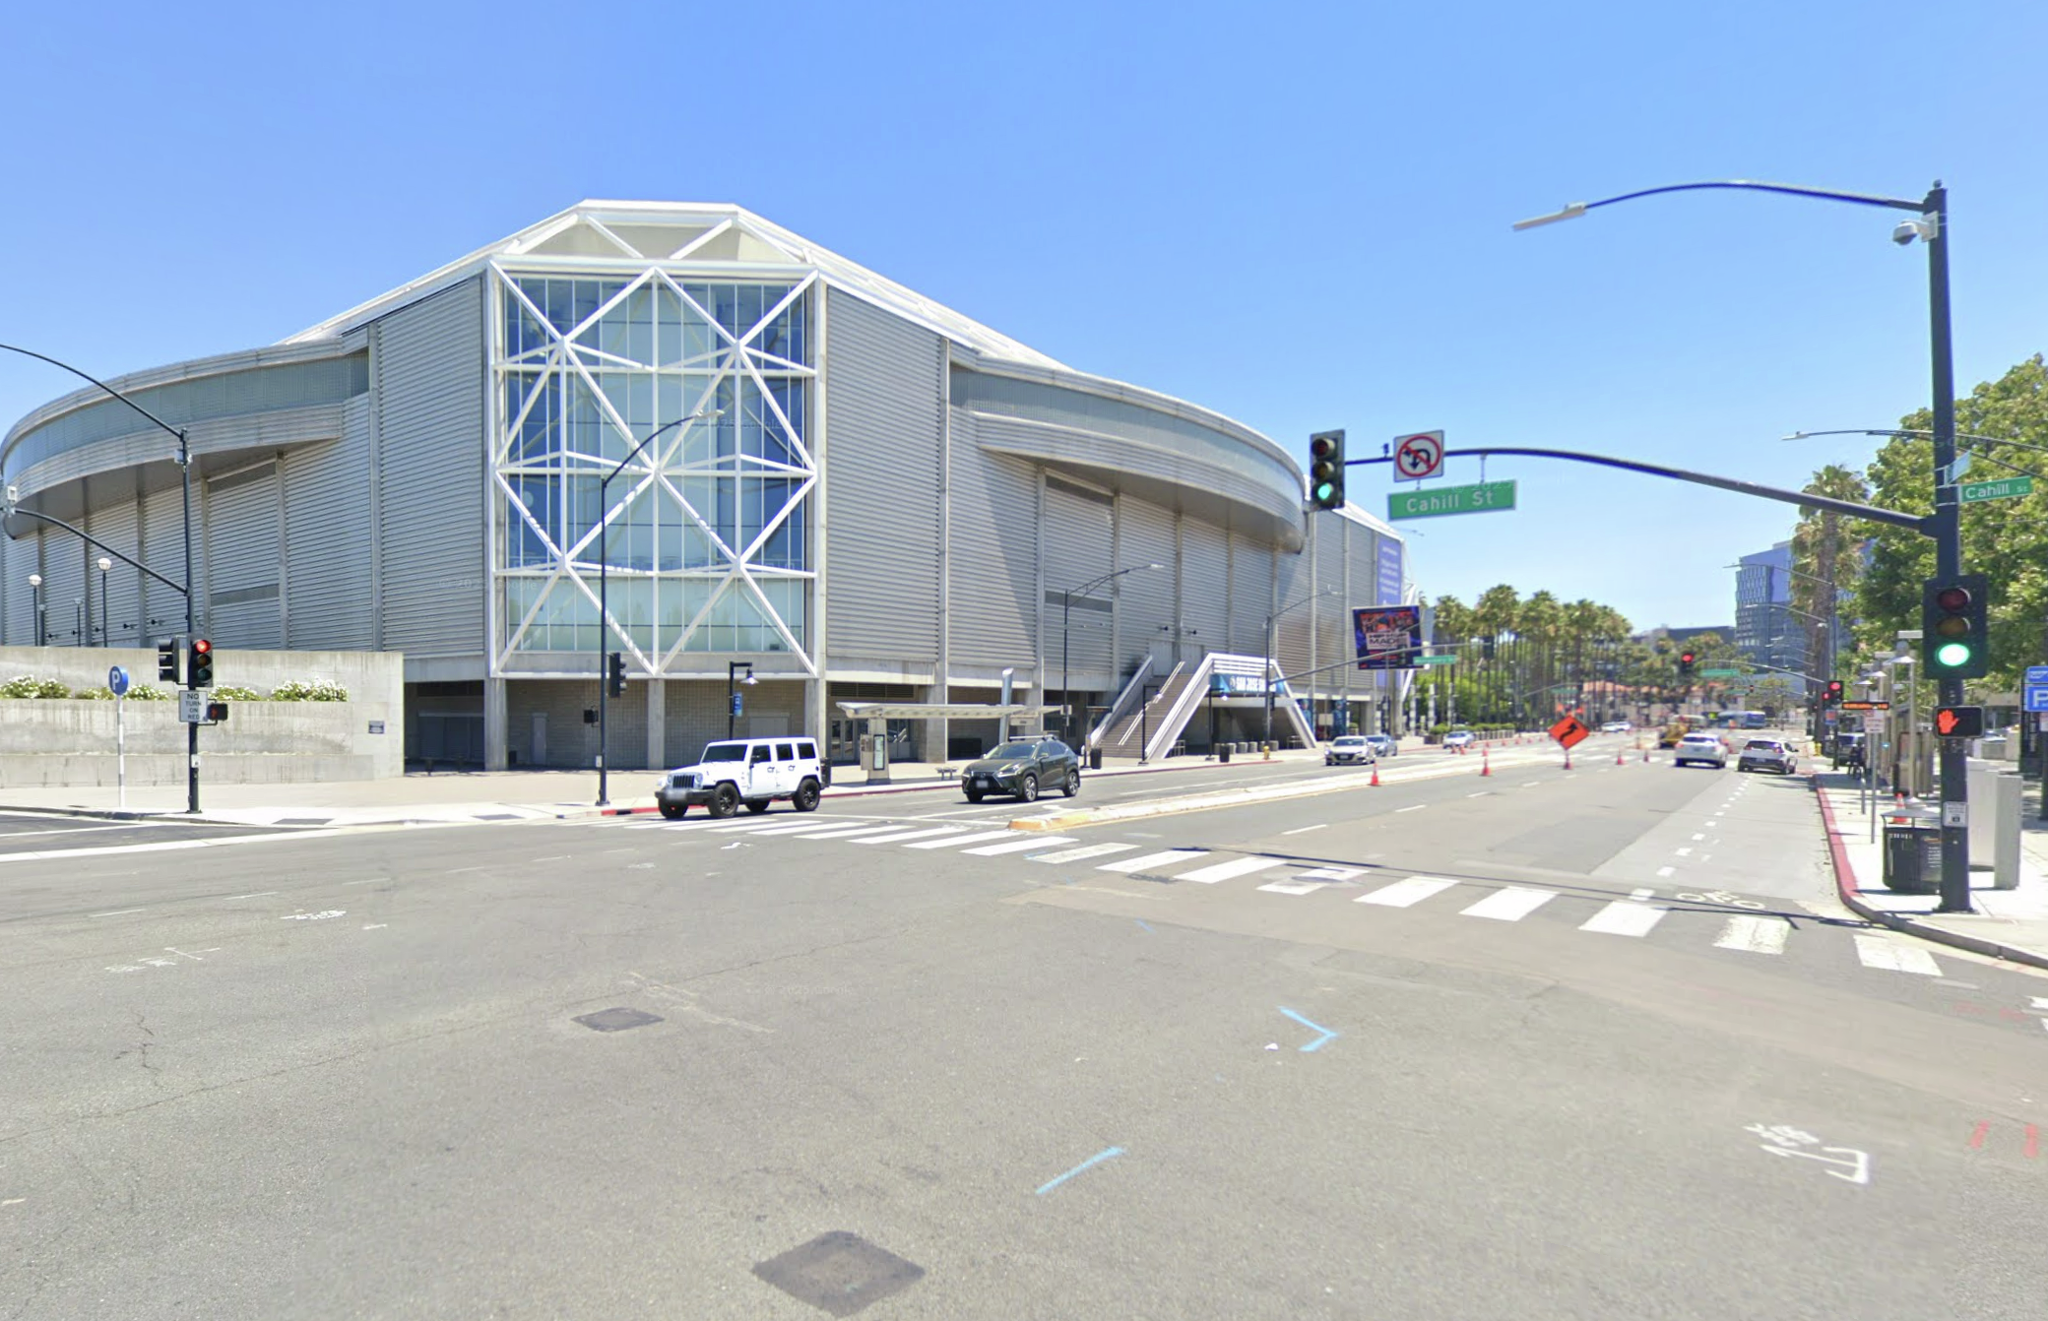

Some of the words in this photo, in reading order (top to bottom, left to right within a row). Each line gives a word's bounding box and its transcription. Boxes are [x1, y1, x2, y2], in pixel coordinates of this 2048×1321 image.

[1965, 483, 2010, 499] Cahill
[1406, 494, 1459, 513] Cahill
[1472, 490, 1493, 506] St
[112, 670, 121, 690] P
